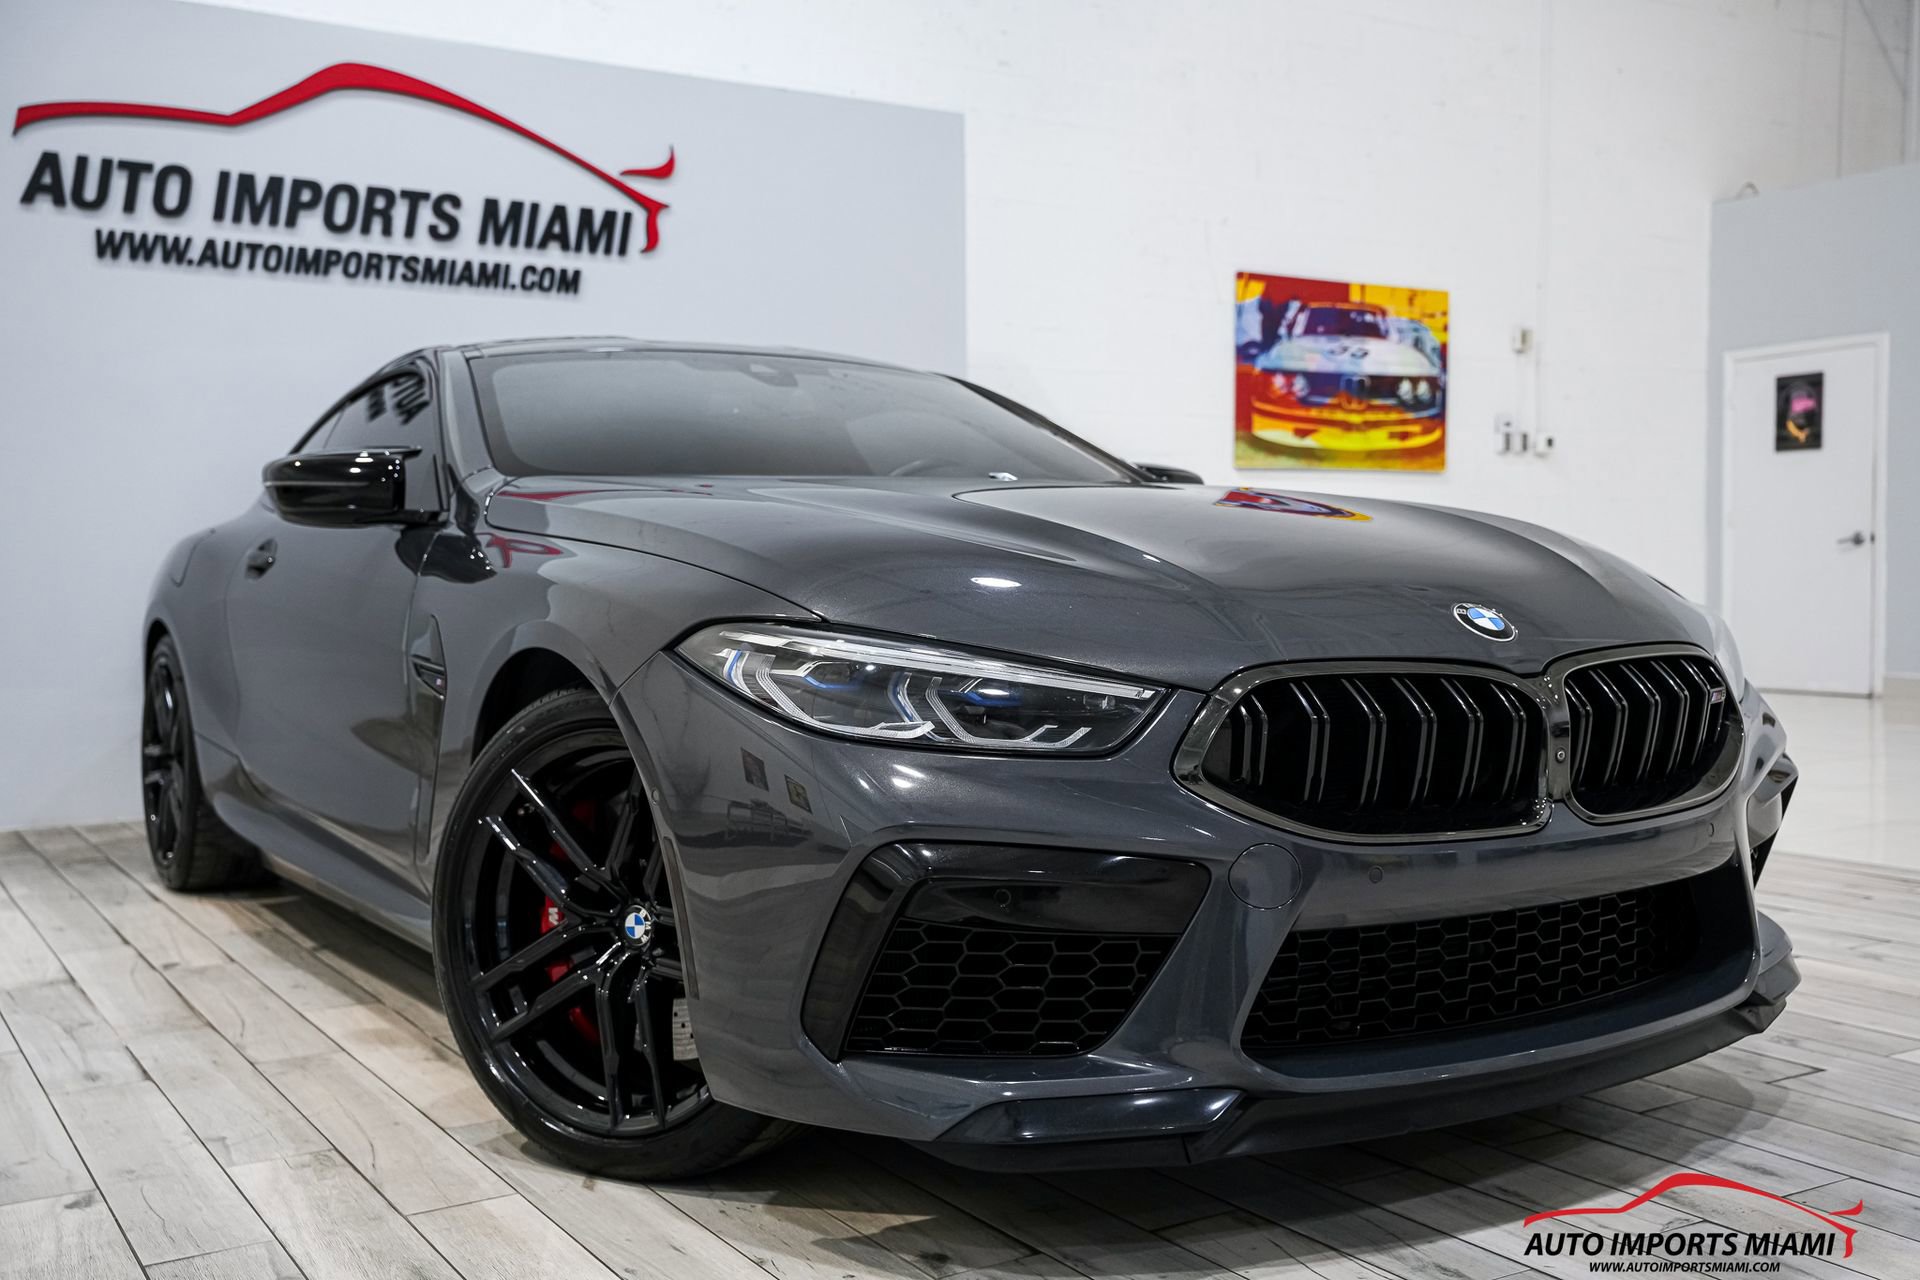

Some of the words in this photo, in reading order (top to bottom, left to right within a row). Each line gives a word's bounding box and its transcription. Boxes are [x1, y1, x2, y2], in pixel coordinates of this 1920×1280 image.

[20, 151, 193, 219] AUTO
[212, 170, 462, 242] IMPORTS
[478, 198, 632, 257] MIAMI
[95, 229, 581, 295] WWW.AUTOIMPORTSMIAMI.COM
[639, 909, 652, 944] BMW
